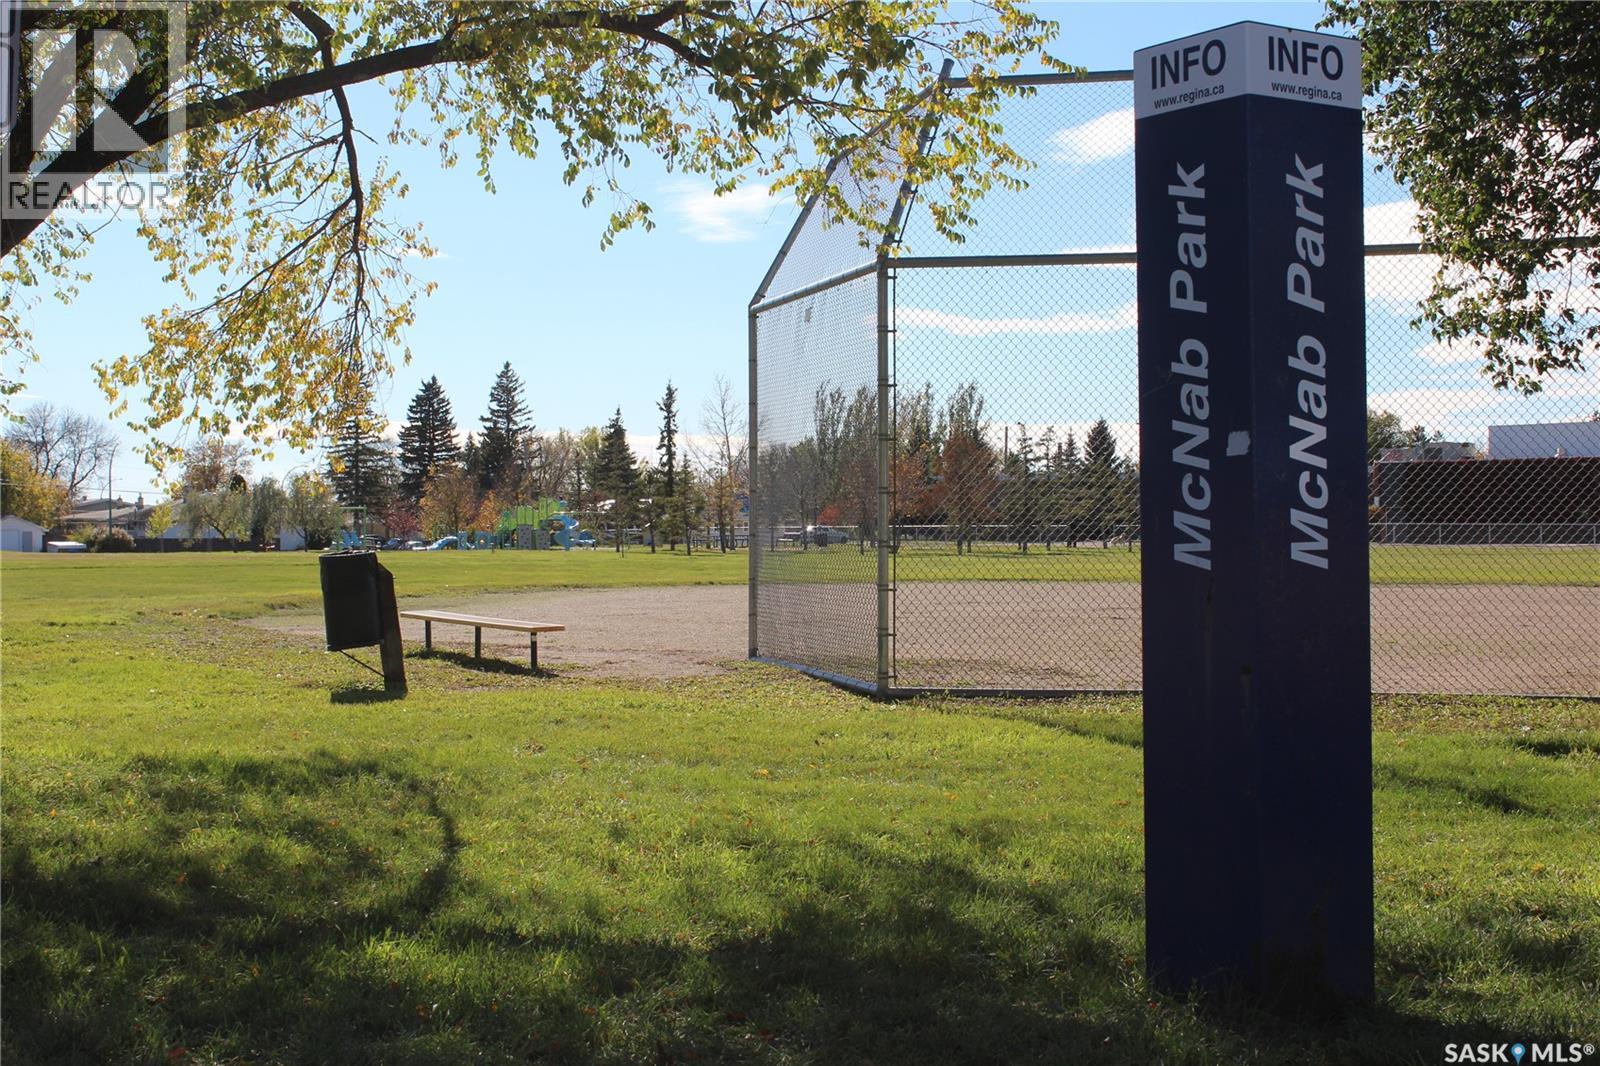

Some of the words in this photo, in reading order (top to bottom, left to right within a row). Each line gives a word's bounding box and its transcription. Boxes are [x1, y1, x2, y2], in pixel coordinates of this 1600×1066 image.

[1151, 39, 1226, 90] INFO
[1154, 84, 1225, 109] www.regina.ca
[1268, 36, 1343, 81] INFO
[1271, 80, 1342, 101] www.regina.ca
[1168, 162, 1207, 313] Park
[1286, 153, 1325, 313] Park
[1171, 338, 1212, 570] McNab
[1288, 335, 1329, 569] McNab
